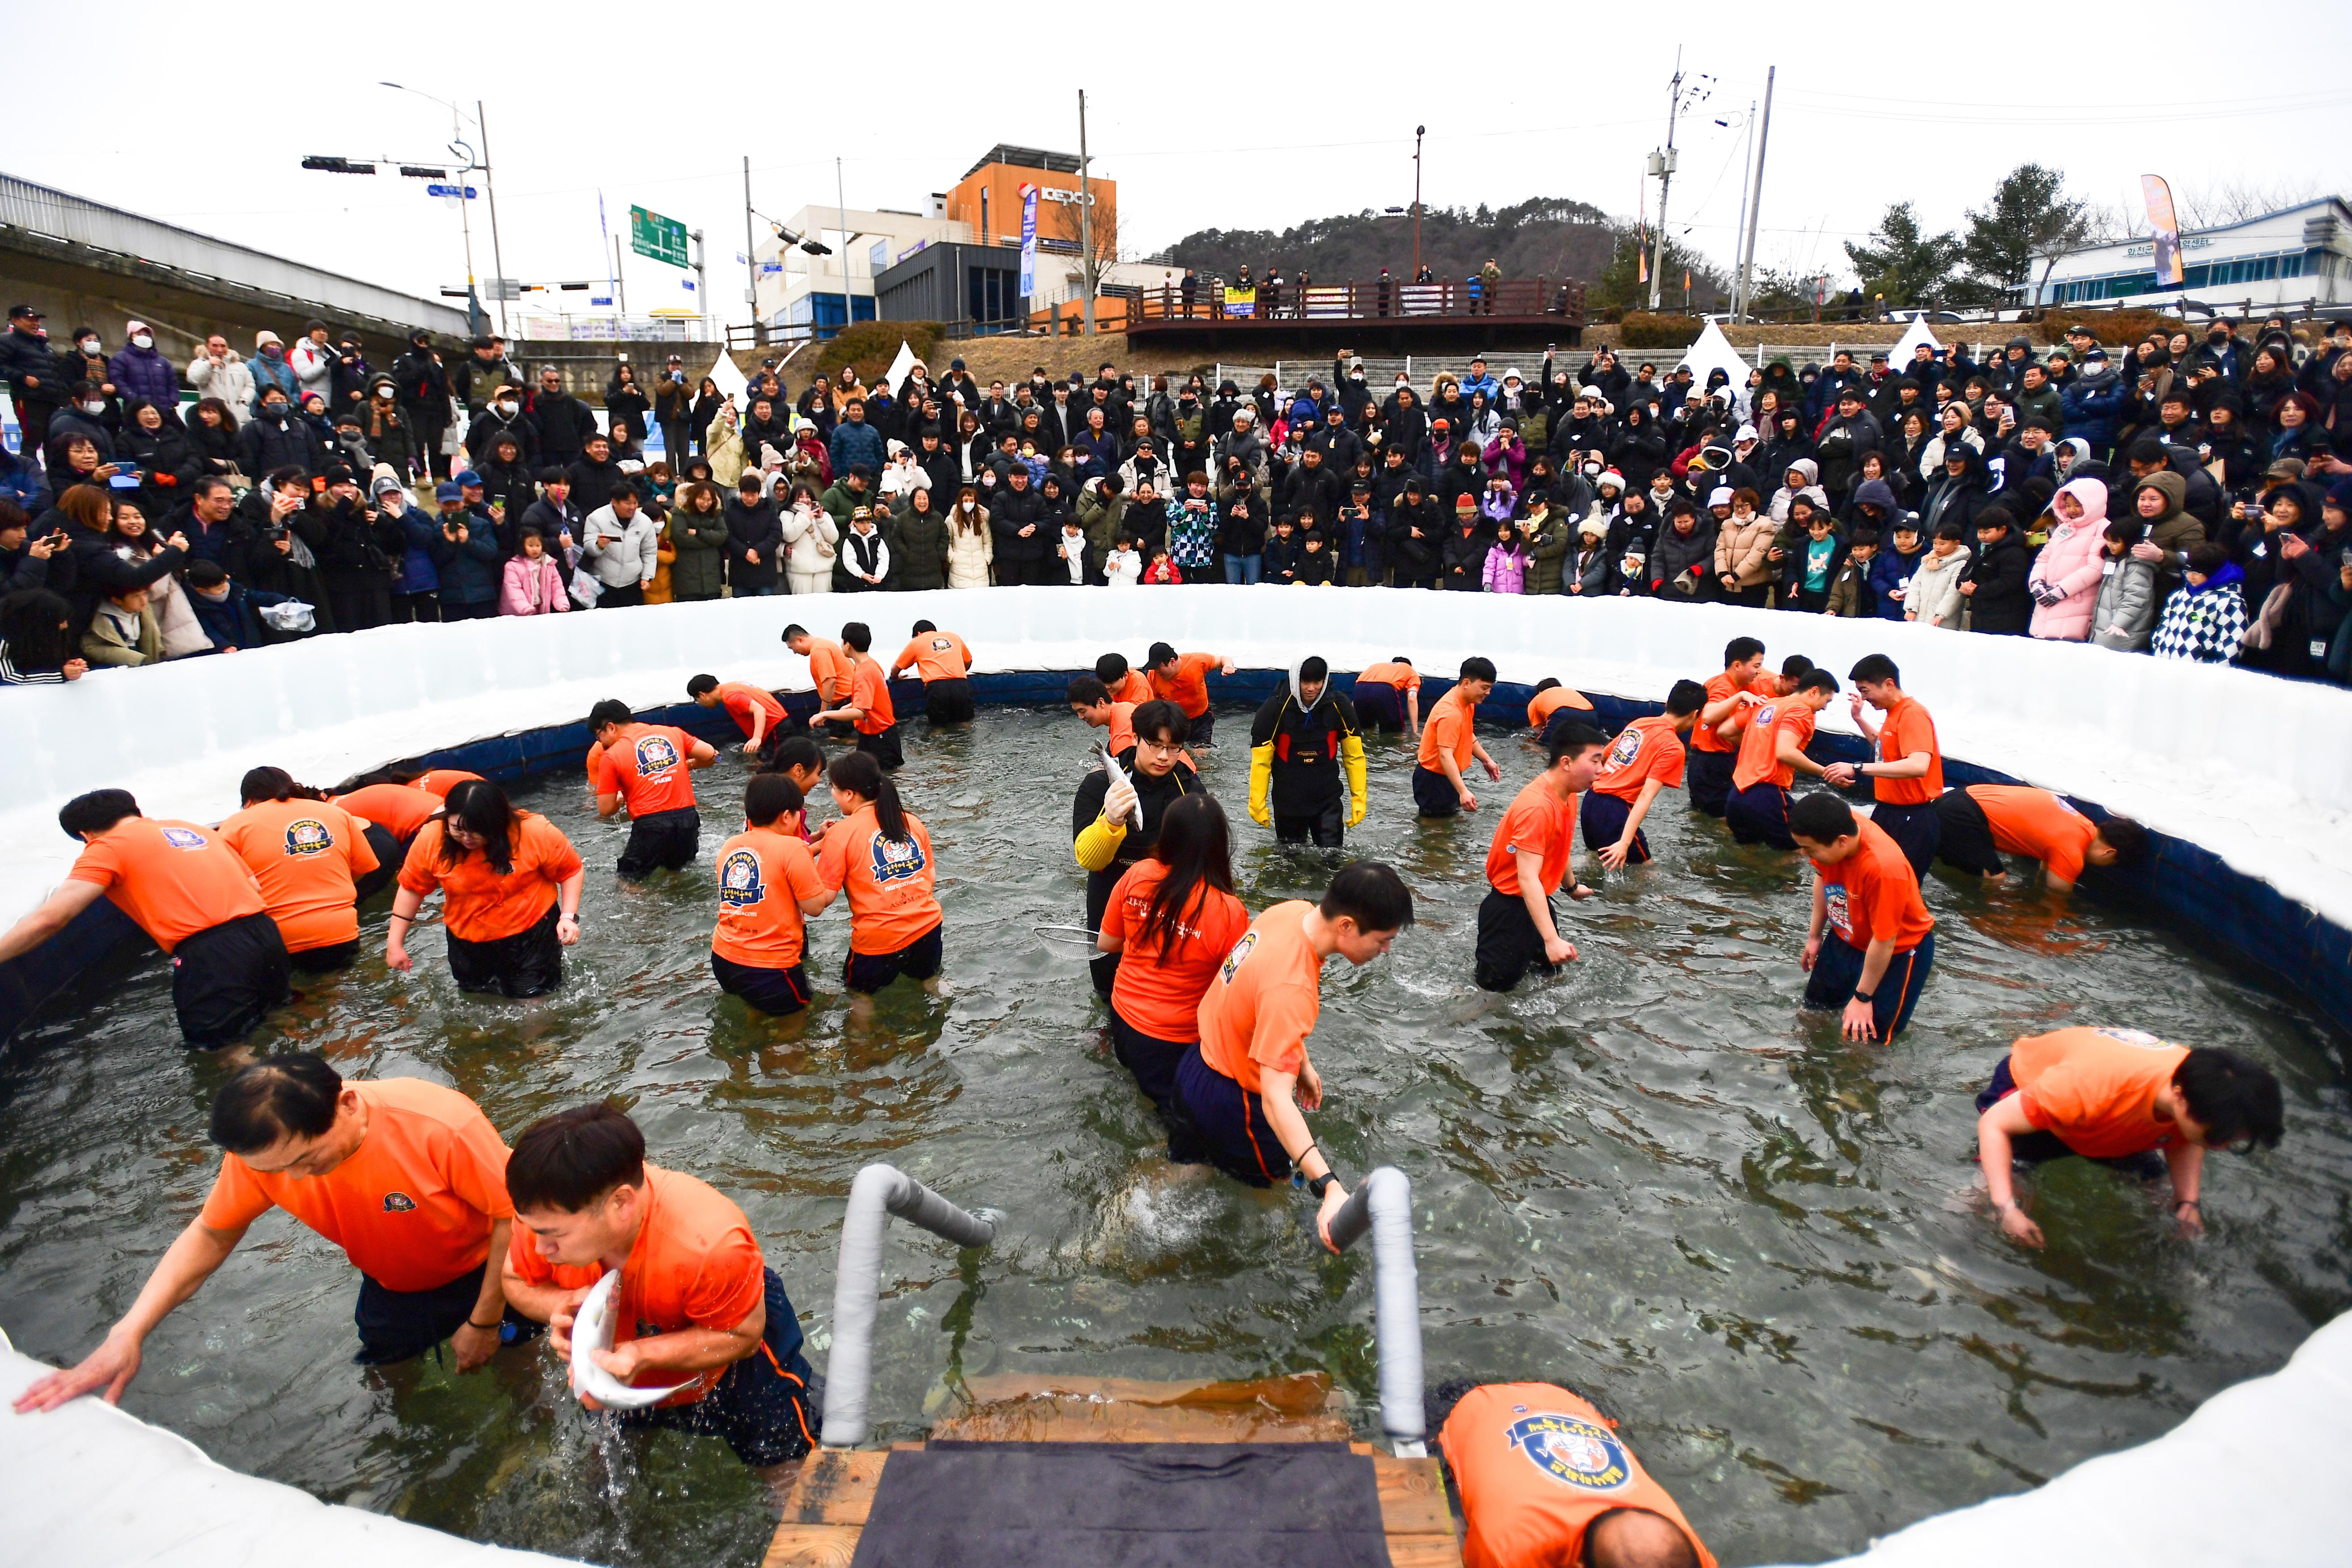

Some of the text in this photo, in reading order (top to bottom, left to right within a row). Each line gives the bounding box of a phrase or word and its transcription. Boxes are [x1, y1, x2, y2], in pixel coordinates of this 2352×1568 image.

[1041, 186, 1095, 206] KEPCO
[2127, 238, 2208, 256] 화천군 역센터
[883, 859, 919, 875] 산천어축제
[1528, 1418, 1608, 1439] 산천어축제
[1550, 1460, 1624, 1486] 얼음나라화천
